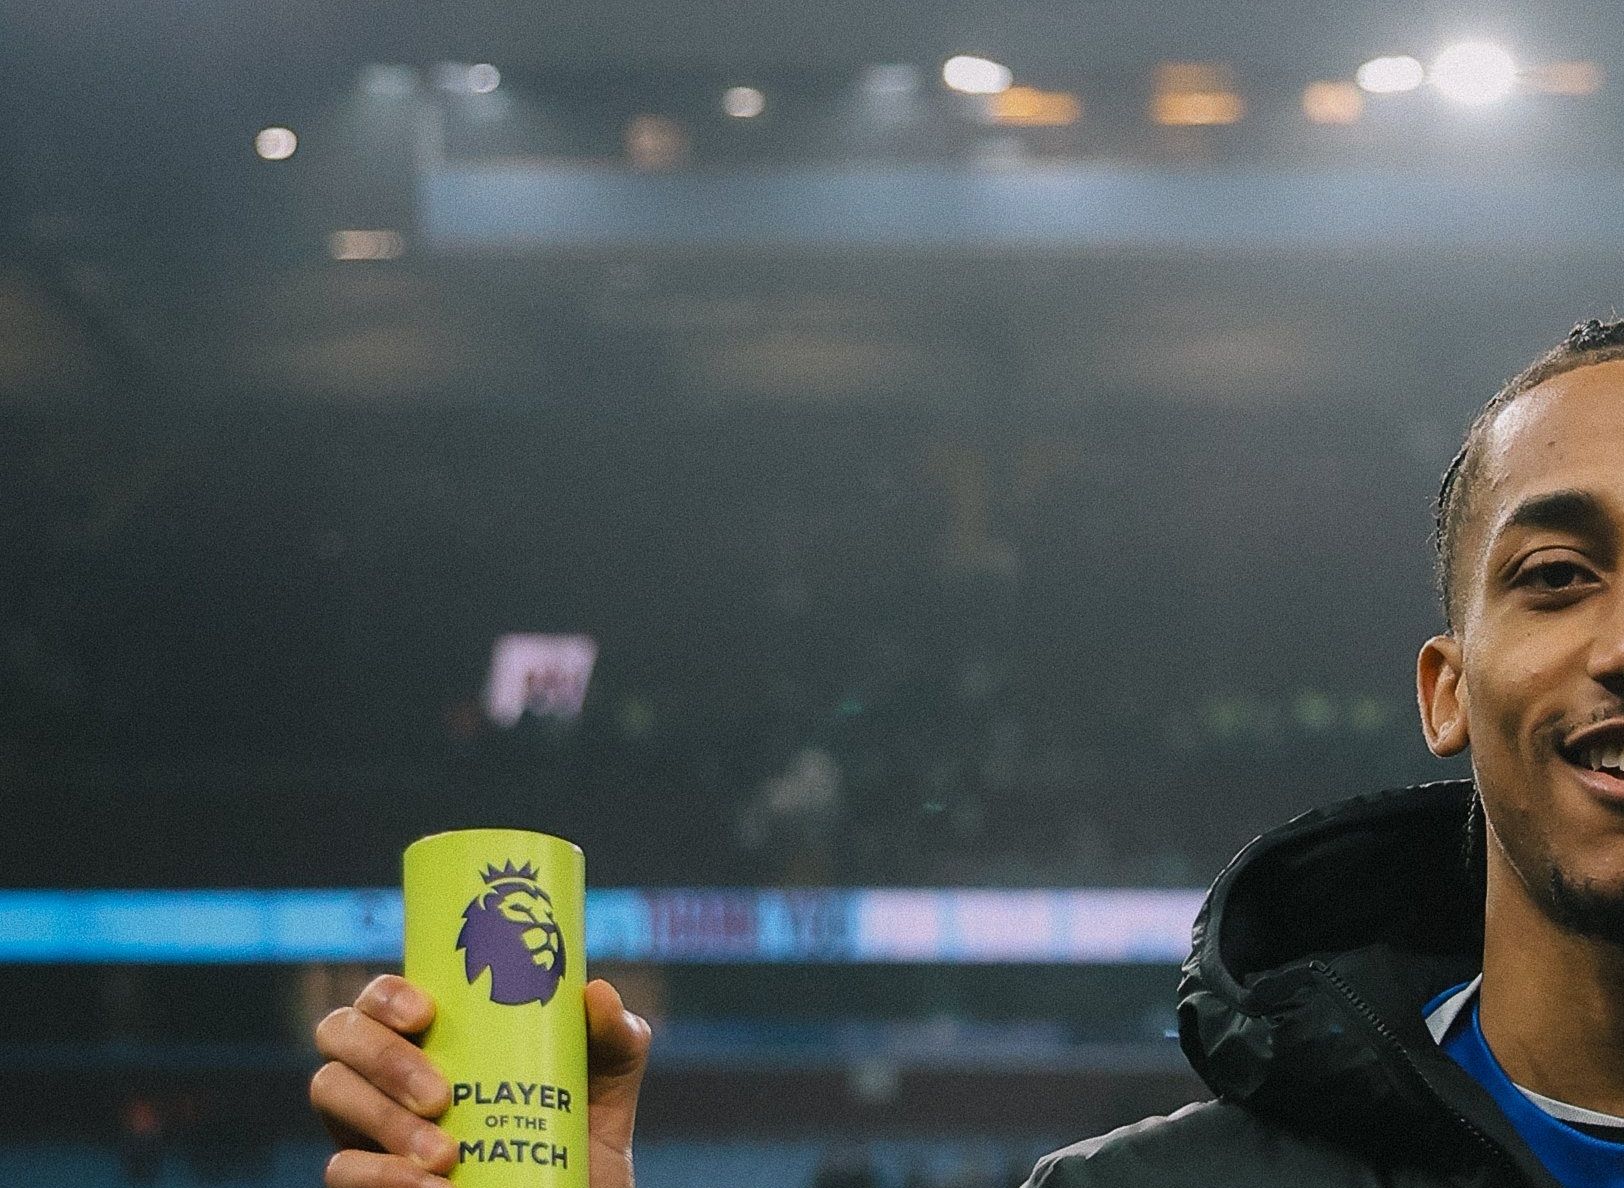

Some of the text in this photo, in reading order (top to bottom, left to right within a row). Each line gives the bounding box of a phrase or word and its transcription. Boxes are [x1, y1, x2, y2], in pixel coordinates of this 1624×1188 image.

[453, 1081, 571, 1113] PLAYER
[485, 1115, 547, 1131] OF THE
[459, 1139, 568, 1170] MATCH
